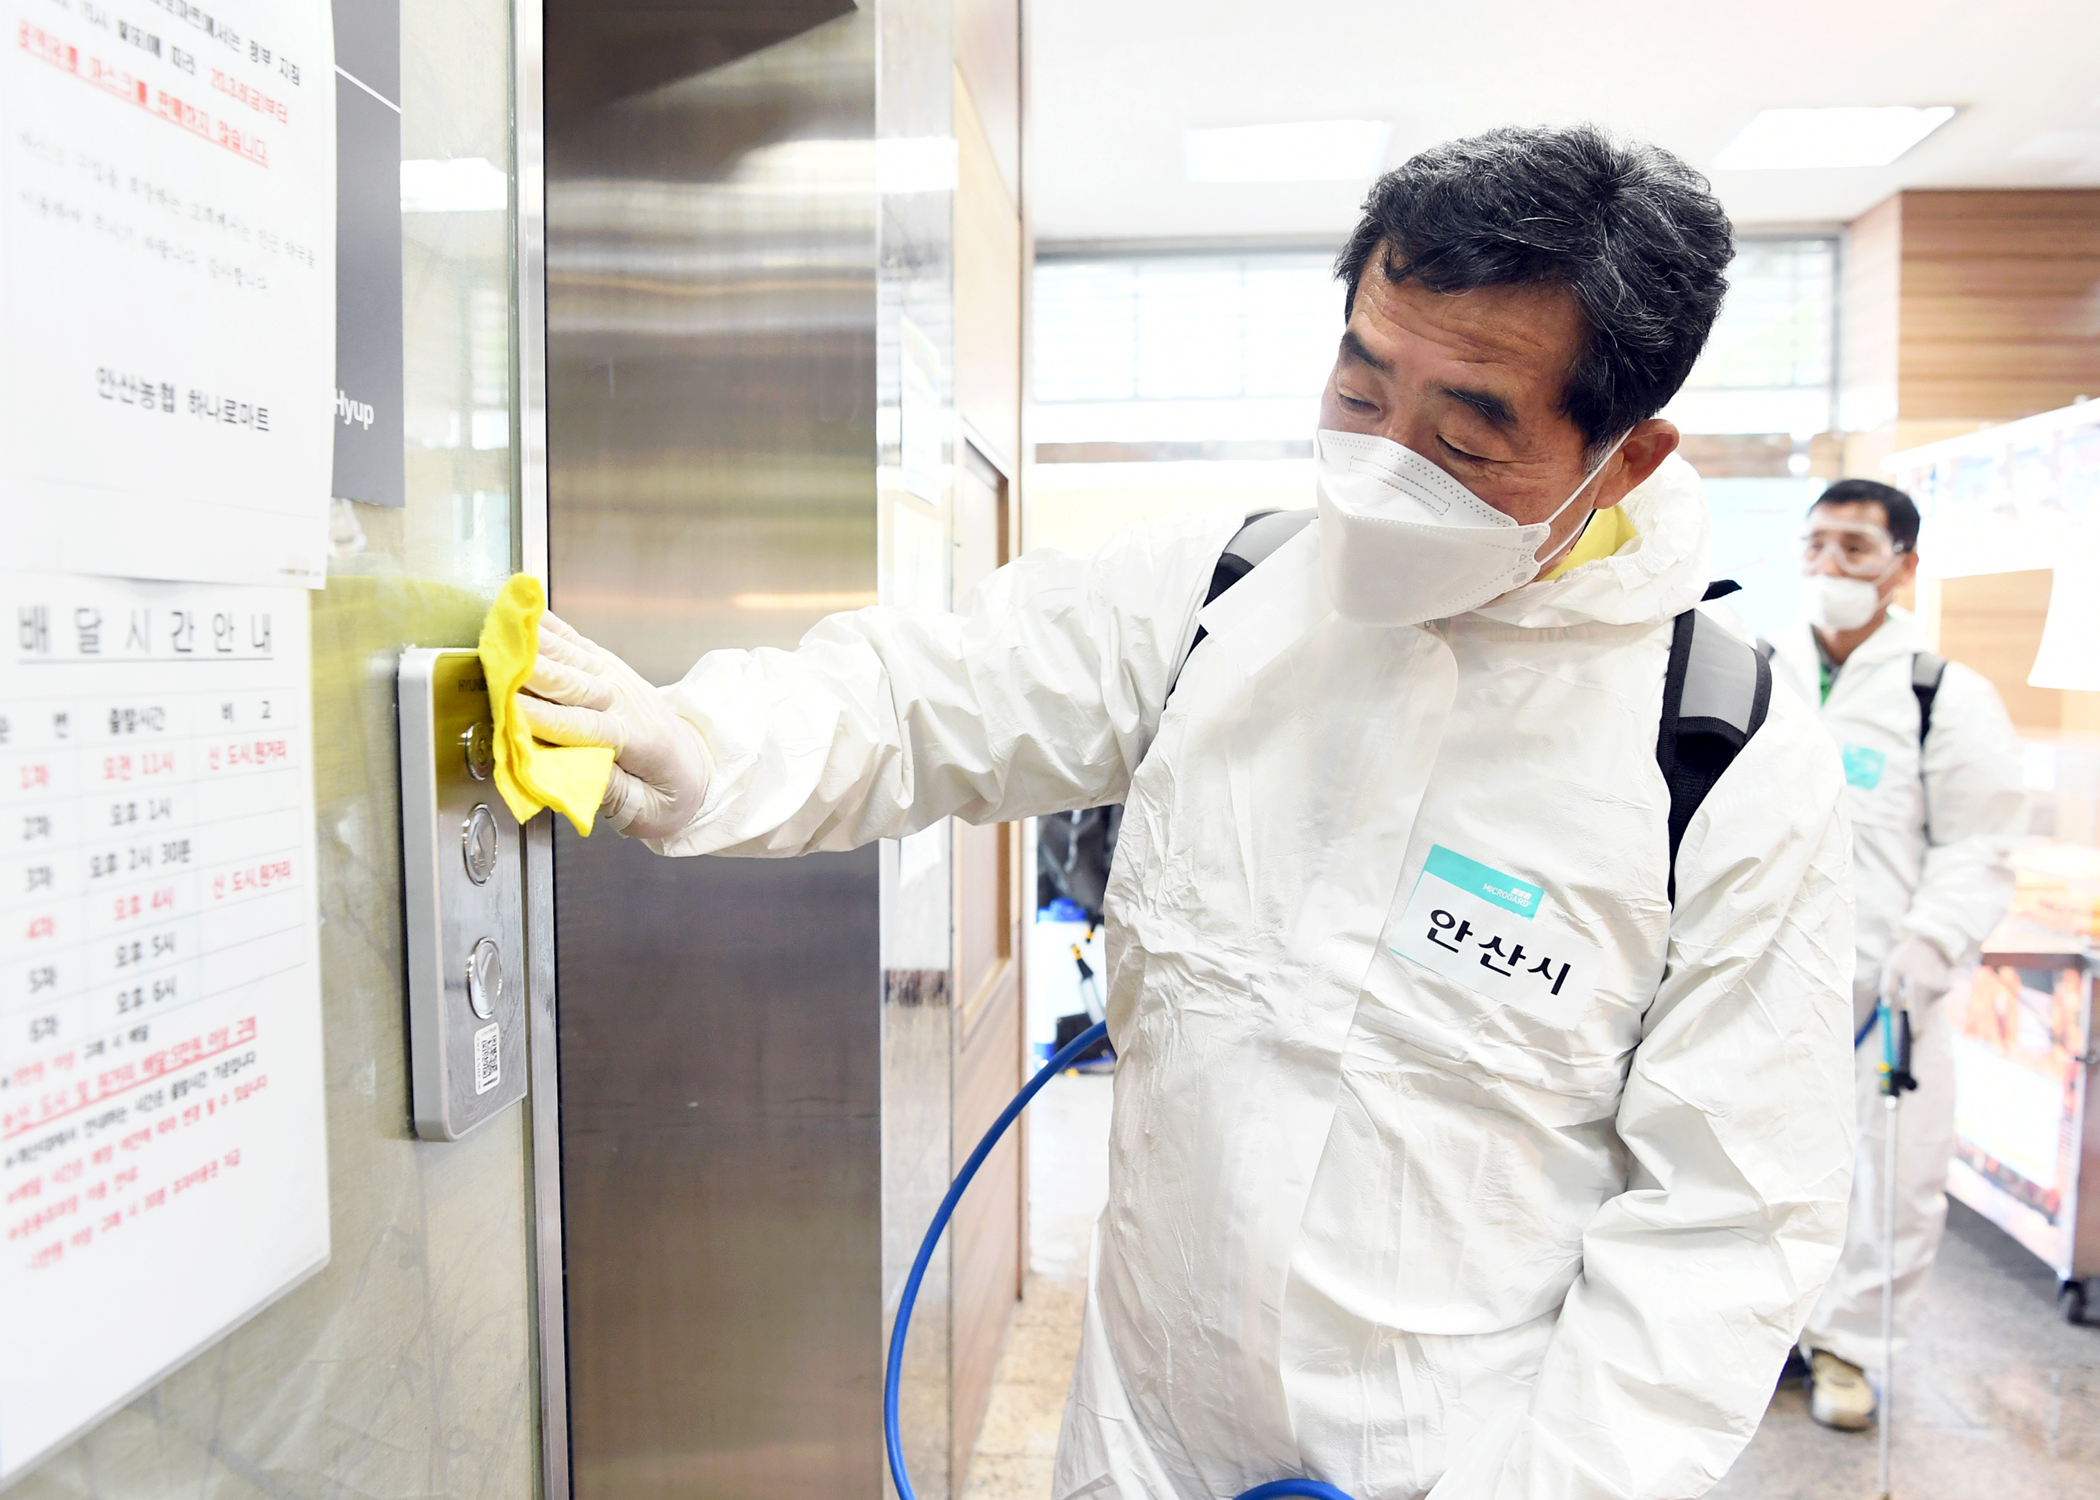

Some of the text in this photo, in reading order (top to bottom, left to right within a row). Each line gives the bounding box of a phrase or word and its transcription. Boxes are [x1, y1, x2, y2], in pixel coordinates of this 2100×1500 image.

[96, 367, 270, 432] 안산농협 하나로마트
[1426, 908, 1572, 997] 안산시
